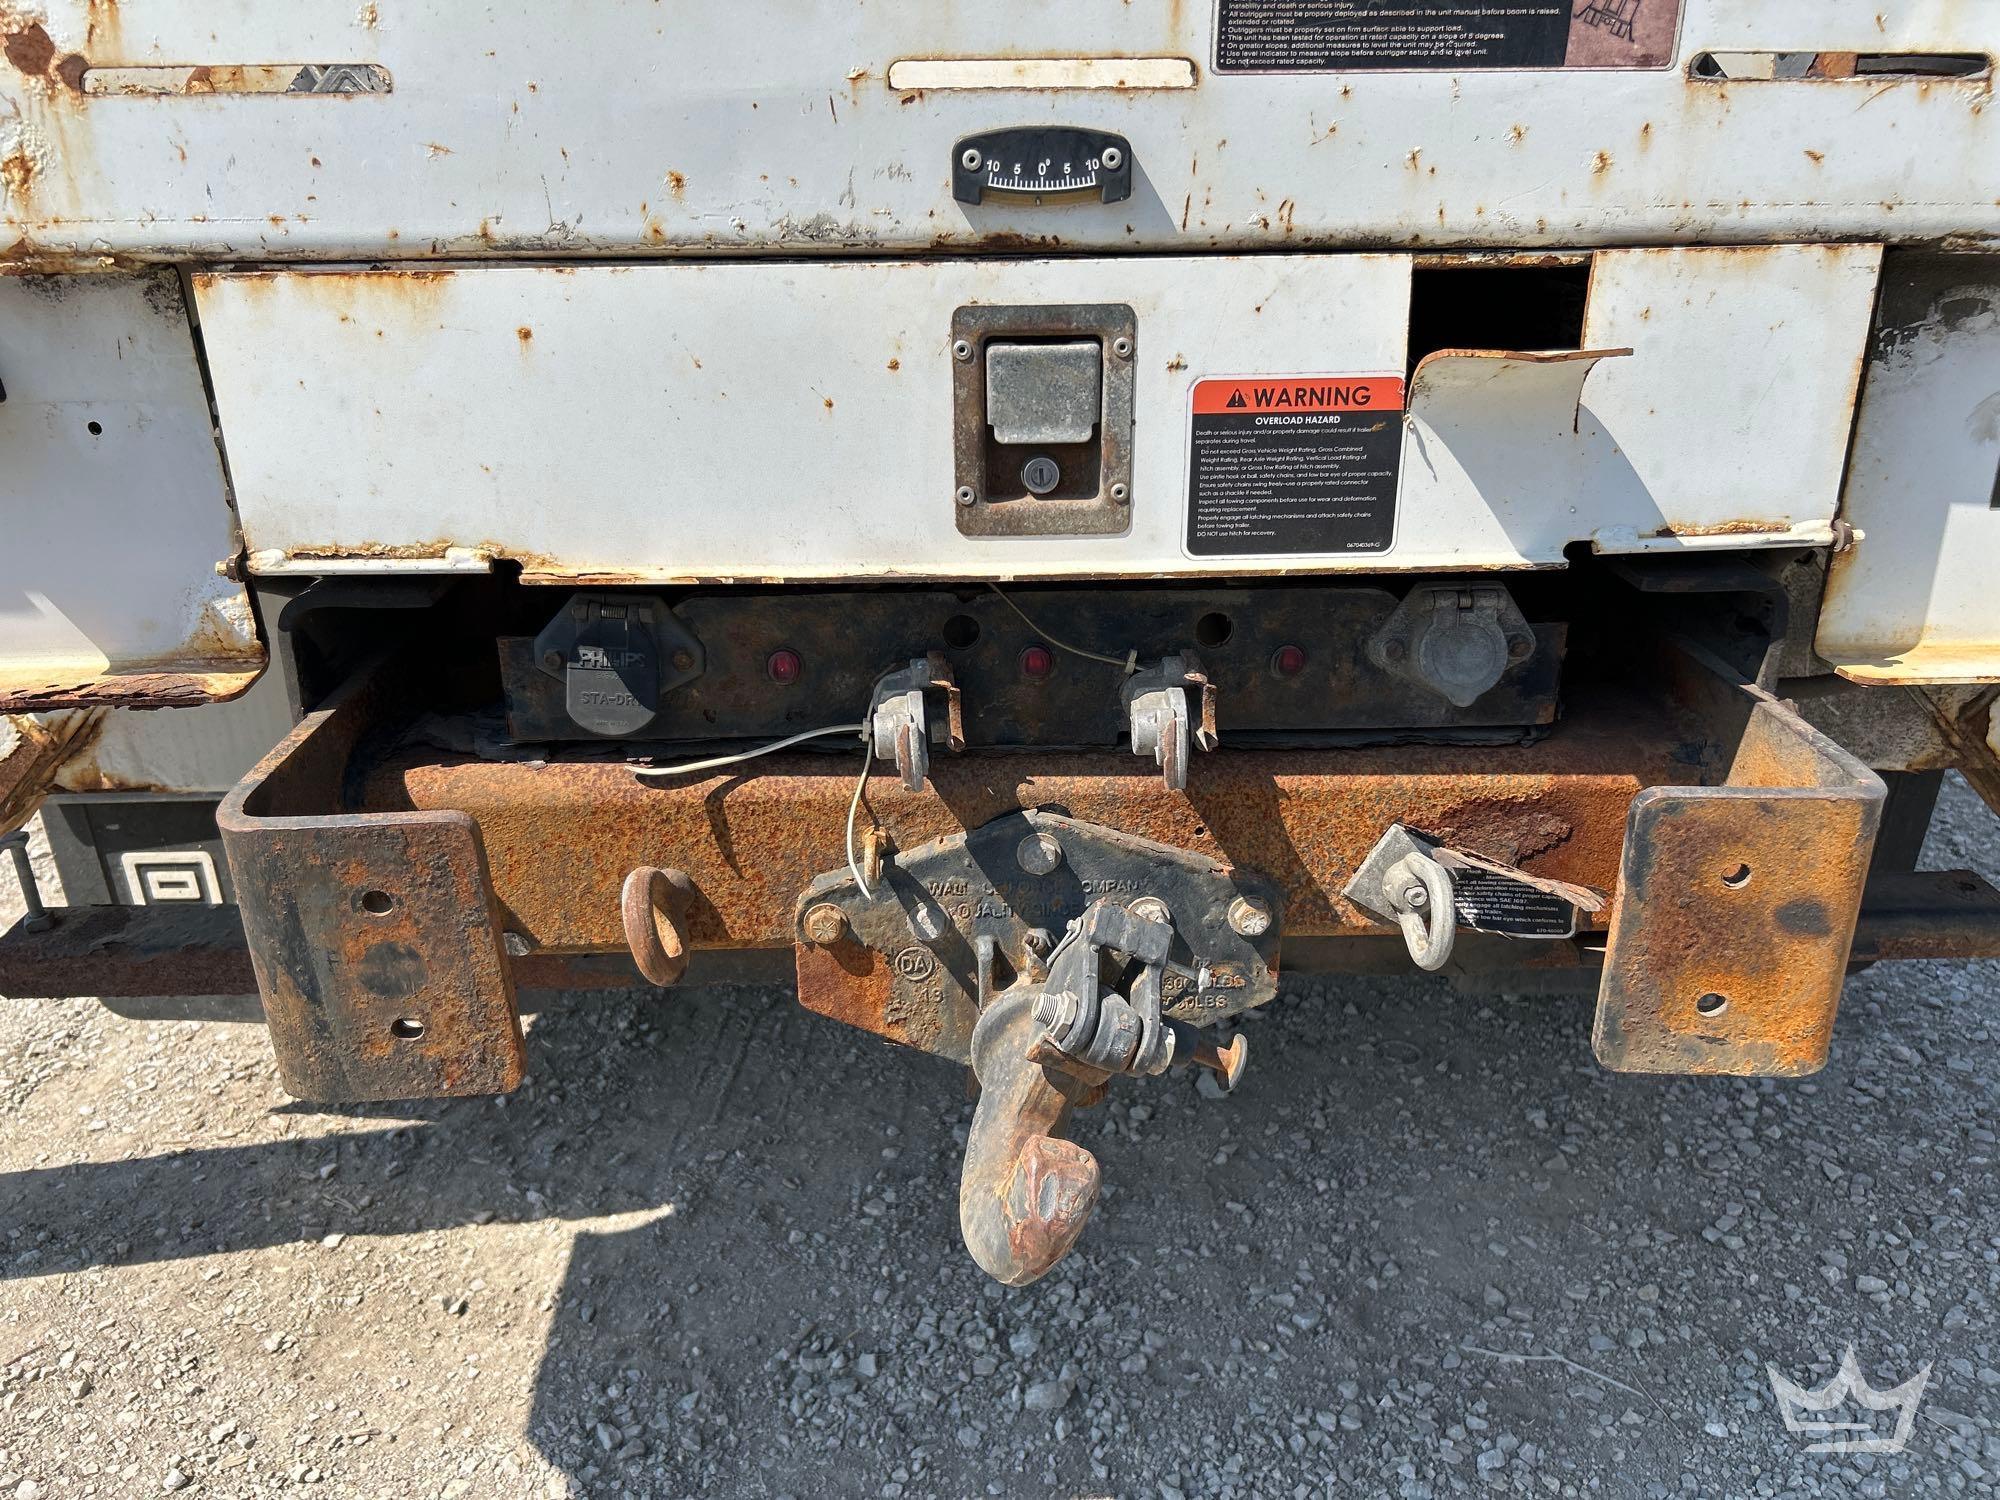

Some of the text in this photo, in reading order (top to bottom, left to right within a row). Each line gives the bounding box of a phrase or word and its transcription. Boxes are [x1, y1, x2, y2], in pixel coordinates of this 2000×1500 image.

[986, 160, 1000, 172] 10
[1014, 163, 1021, 174] 5
[1064, 162, 1071, 174] 5
[1085, 158, 1100, 171] 10
[1254, 386, 1371, 407] WARNING
[1255, 416, 1341, 425] OVERLOAD HAZARD
[900, 955, 928, 972] DA
